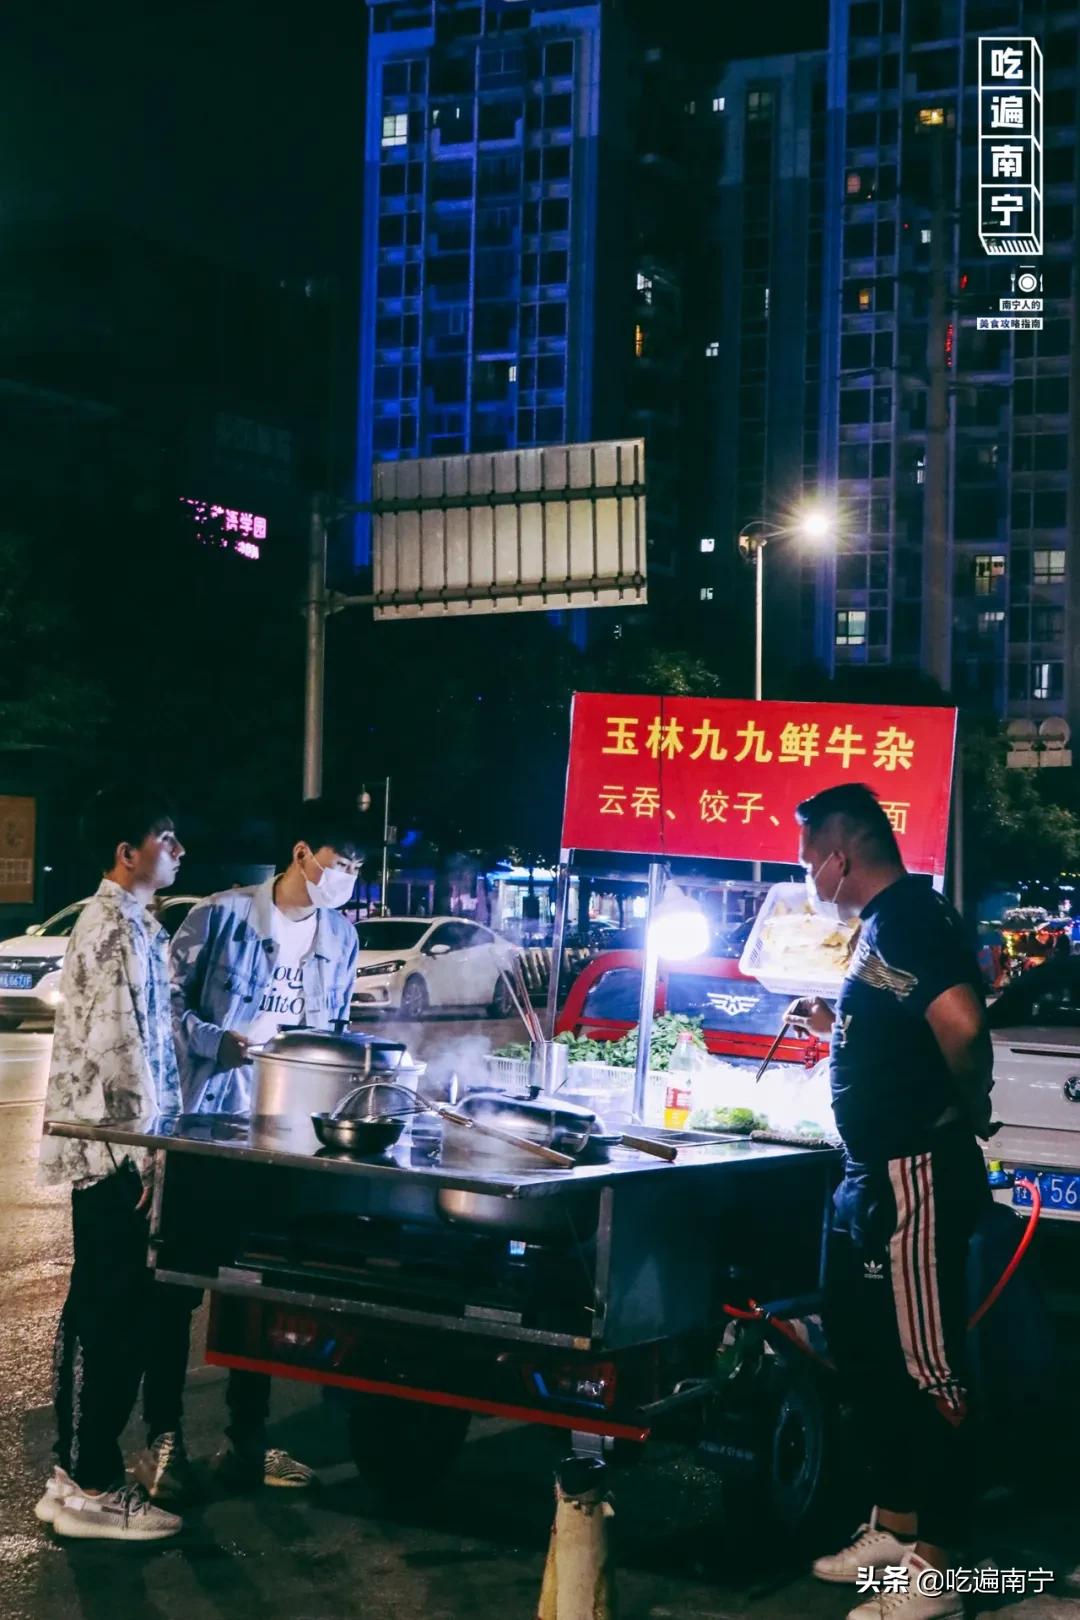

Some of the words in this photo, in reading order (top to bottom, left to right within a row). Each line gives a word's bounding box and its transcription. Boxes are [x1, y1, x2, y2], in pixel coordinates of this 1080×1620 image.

[602, 716, 915, 771] 玉林九九鲜牛杂
